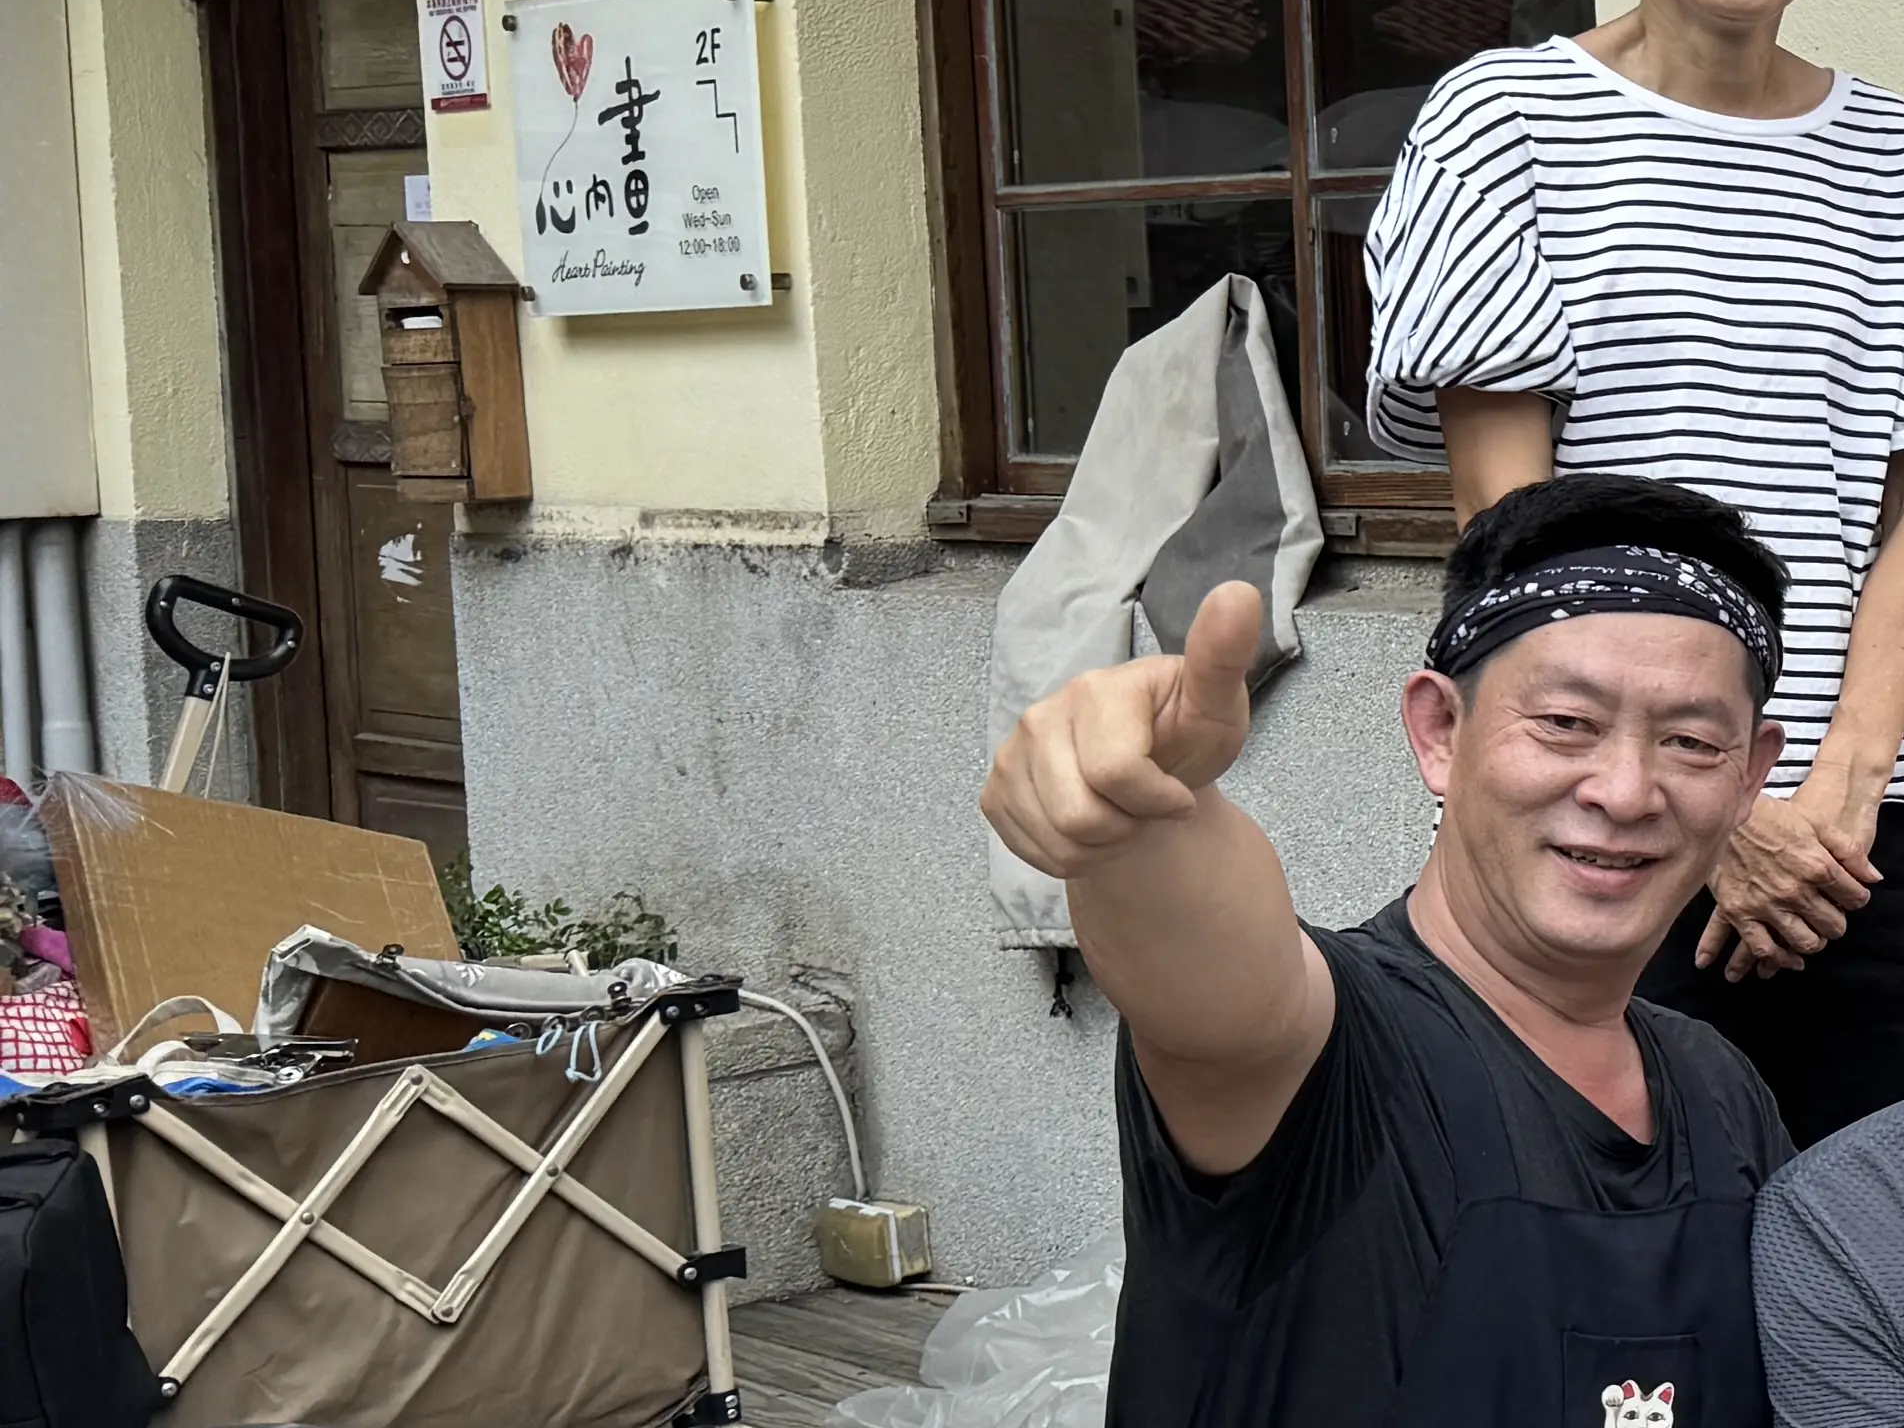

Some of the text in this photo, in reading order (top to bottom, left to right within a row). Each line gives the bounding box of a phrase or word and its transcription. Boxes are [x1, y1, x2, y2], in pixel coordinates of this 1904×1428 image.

[695, 27, 722, 66] 2F
[691, 184, 720, 204] Open
[552, 247, 646, 287] Heart Painting
